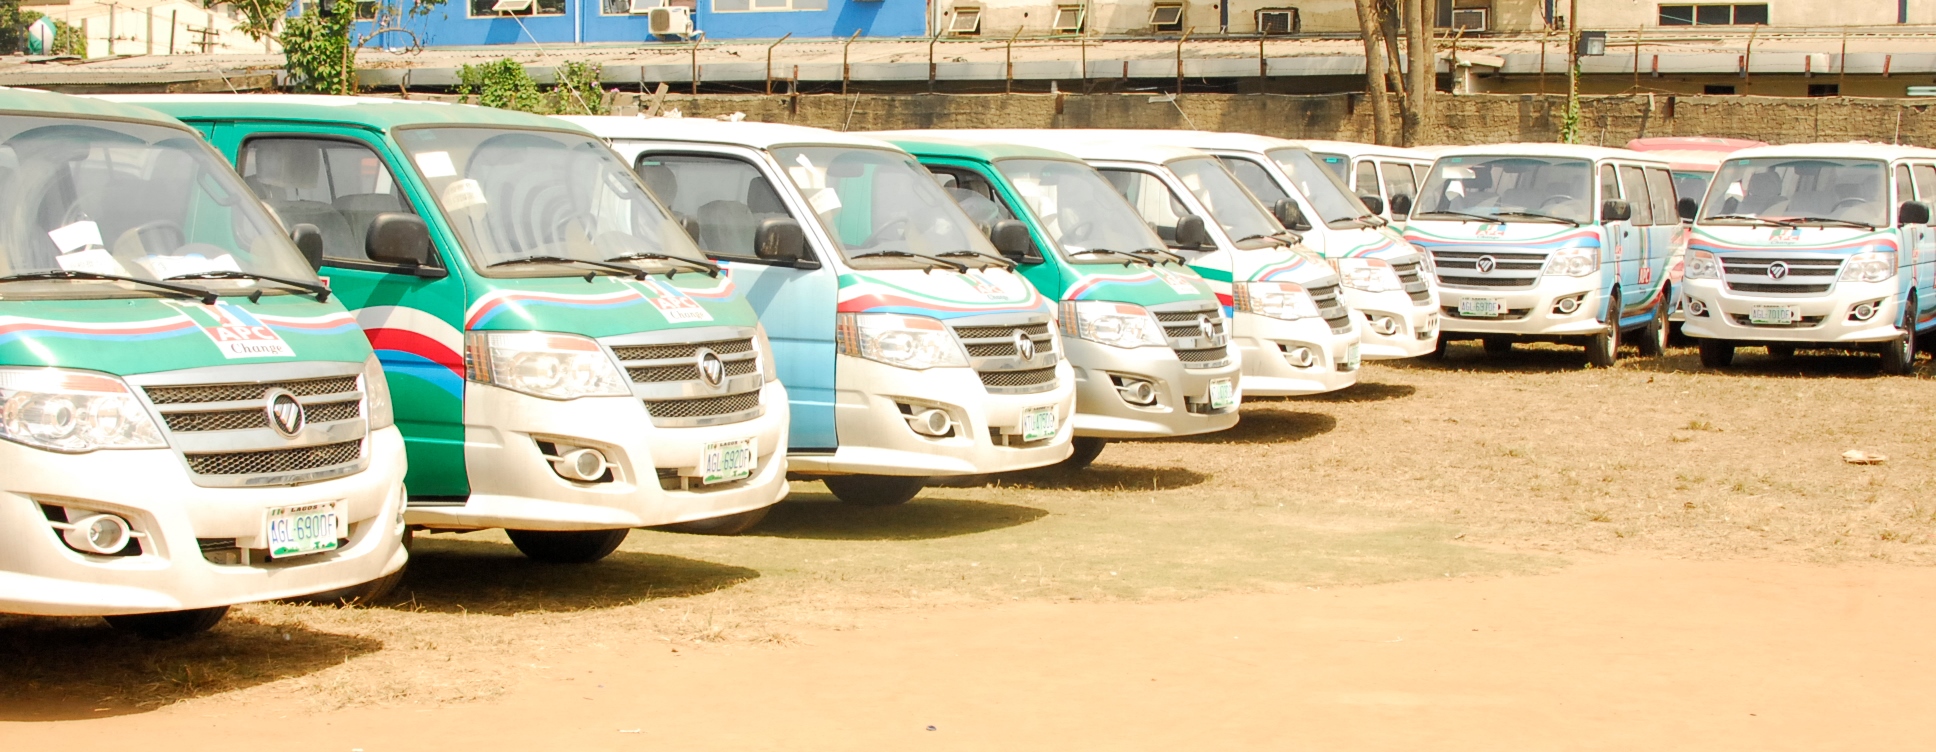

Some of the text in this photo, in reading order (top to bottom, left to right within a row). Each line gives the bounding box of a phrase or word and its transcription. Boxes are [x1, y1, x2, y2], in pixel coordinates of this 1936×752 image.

[656, 296, 699, 309] APC
[670, 310, 704, 320] Change
[216, 326, 275, 341] APC
[230, 342, 282, 355] Change
[706, 448, 749, 474] AGL-692DF
[291, 504, 318, 513] LAGOS
[271, 513, 335, 545] AGL-690DF
